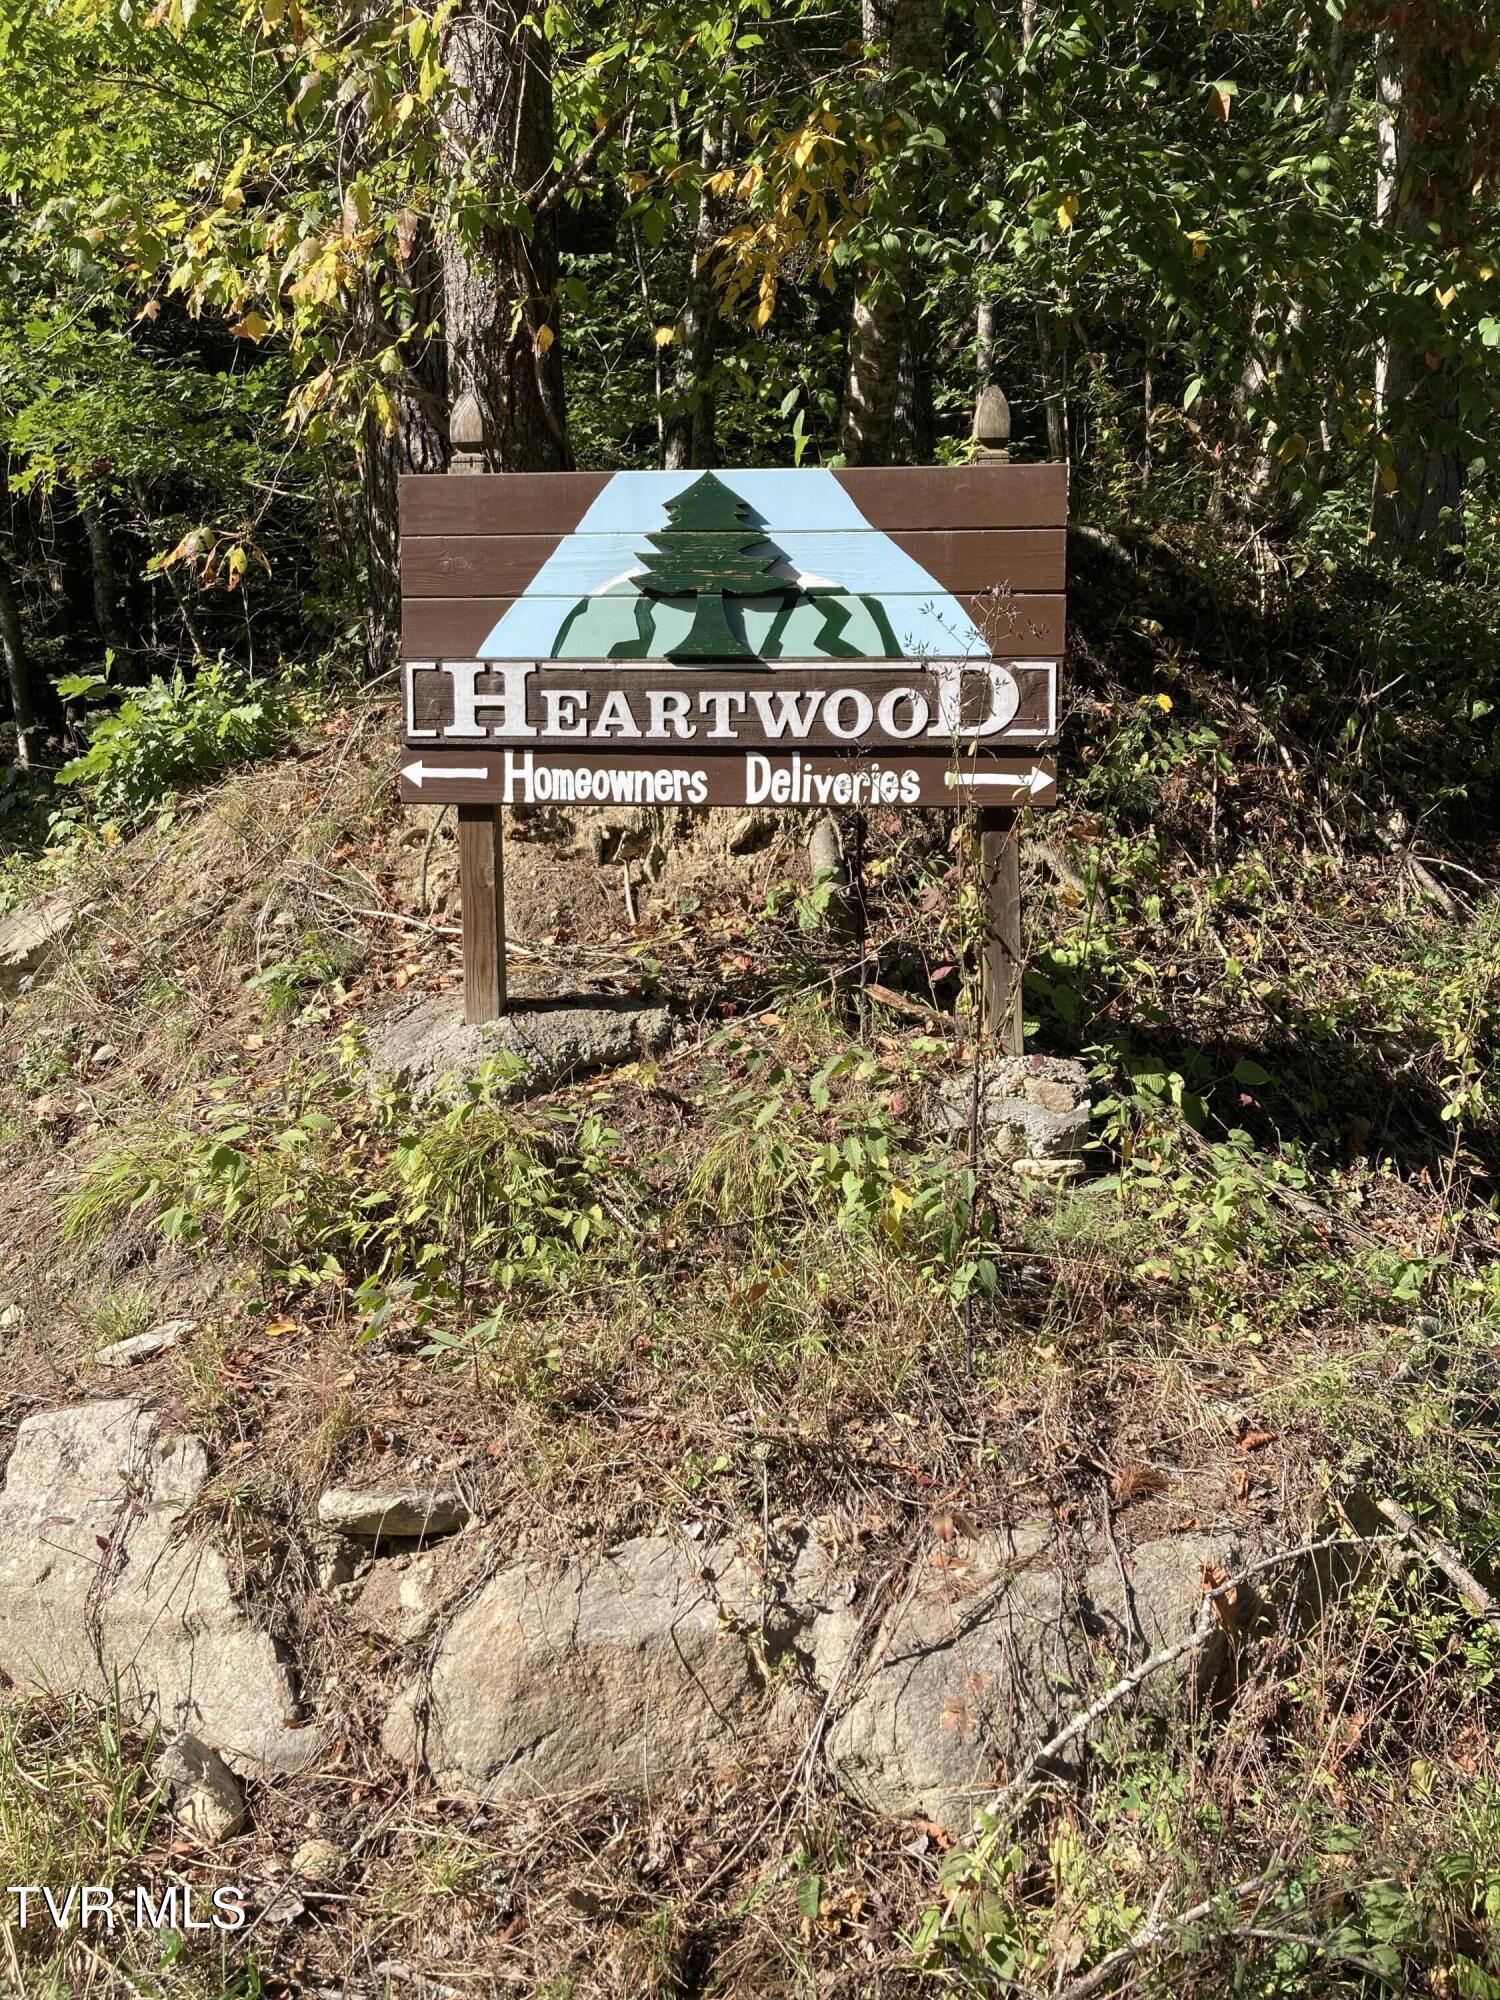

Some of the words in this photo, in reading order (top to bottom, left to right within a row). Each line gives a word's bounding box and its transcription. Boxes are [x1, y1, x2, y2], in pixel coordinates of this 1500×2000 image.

[442, 662, 1020, 739] HEARTWOOD
[502, 749, 709, 803] Homeowners
[745, 751, 921, 804] Deliveries
